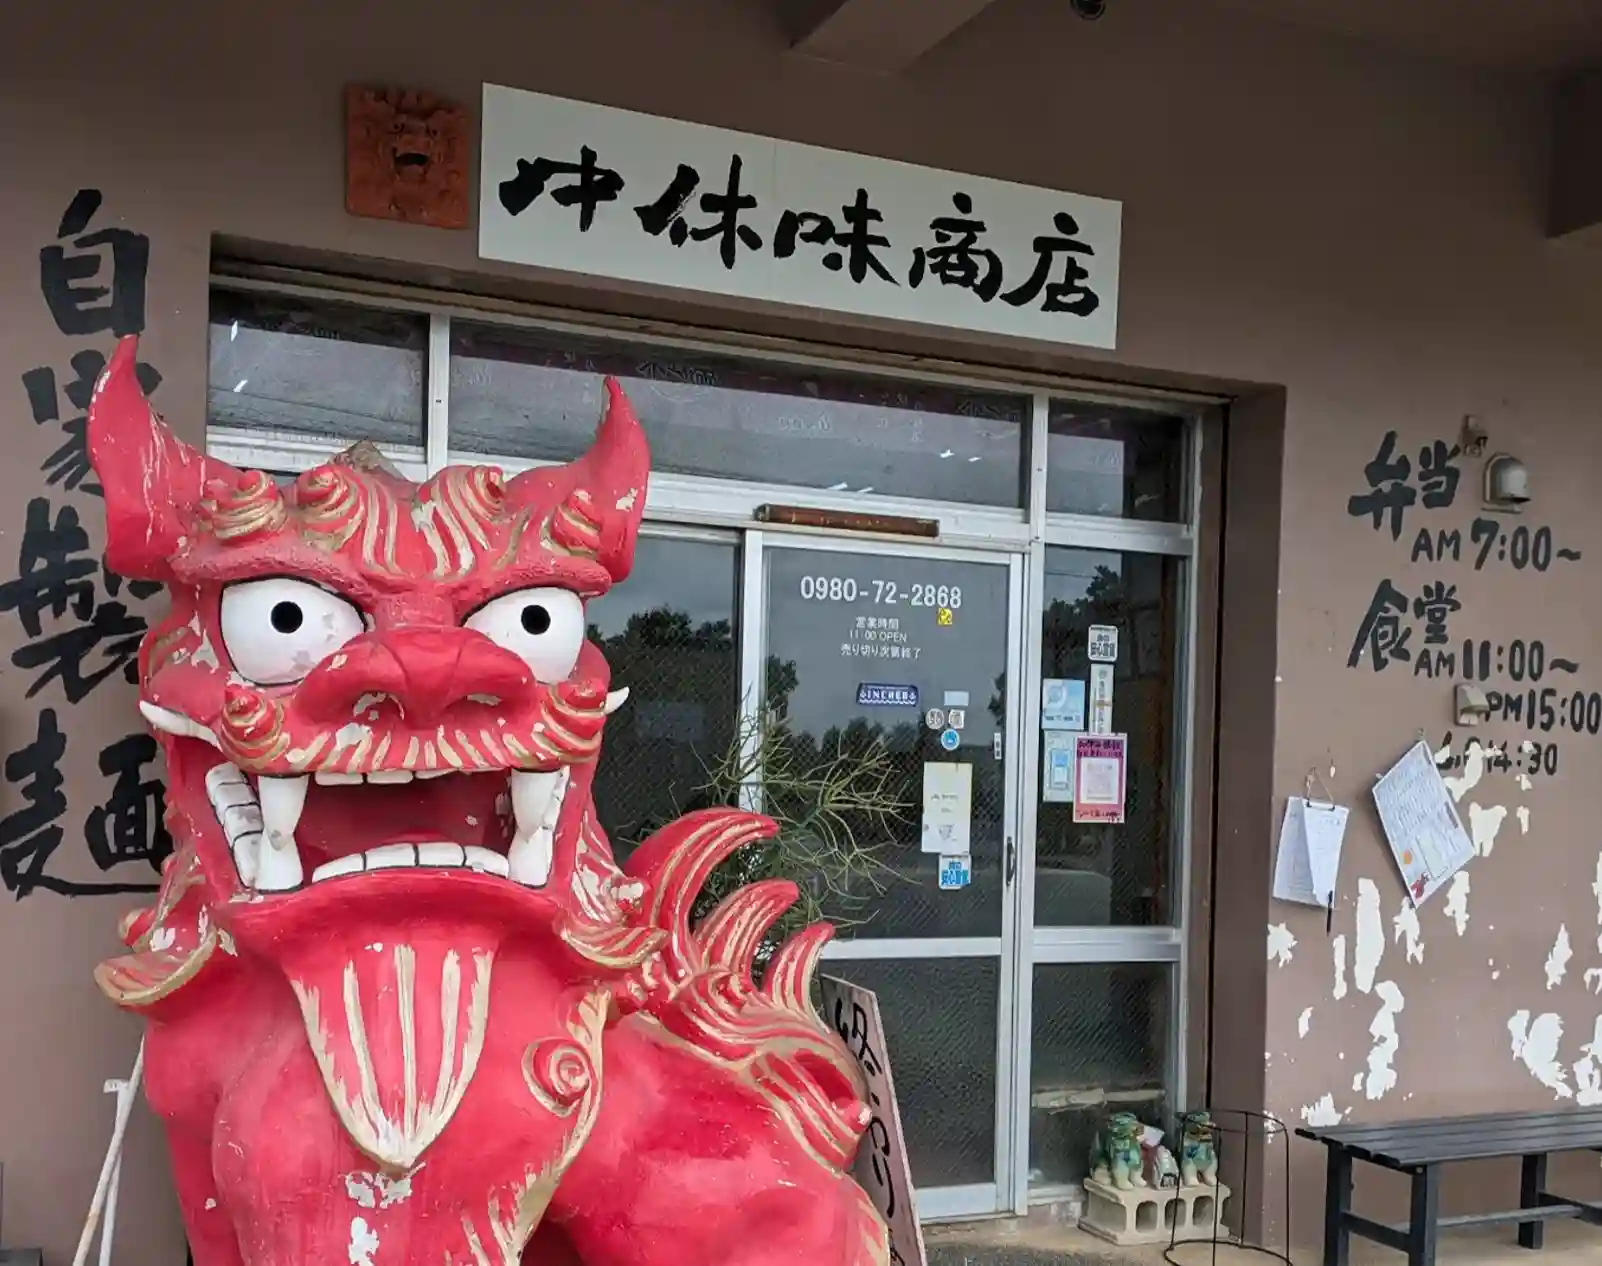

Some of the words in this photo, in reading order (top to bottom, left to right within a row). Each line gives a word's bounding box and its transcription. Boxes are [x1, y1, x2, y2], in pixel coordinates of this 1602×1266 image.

[1348, 431, 1460, 541] 弁当
[1411, 528, 1461, 562] AM
[800, 575, 962, 608] 0980-72-2868
[856, 616, 899, 631] 営業時間
[878, 631, 908, 643] OPEN
[1347, 579, 1462, 672] 食堂
[1415, 649, 1455, 678] AM
